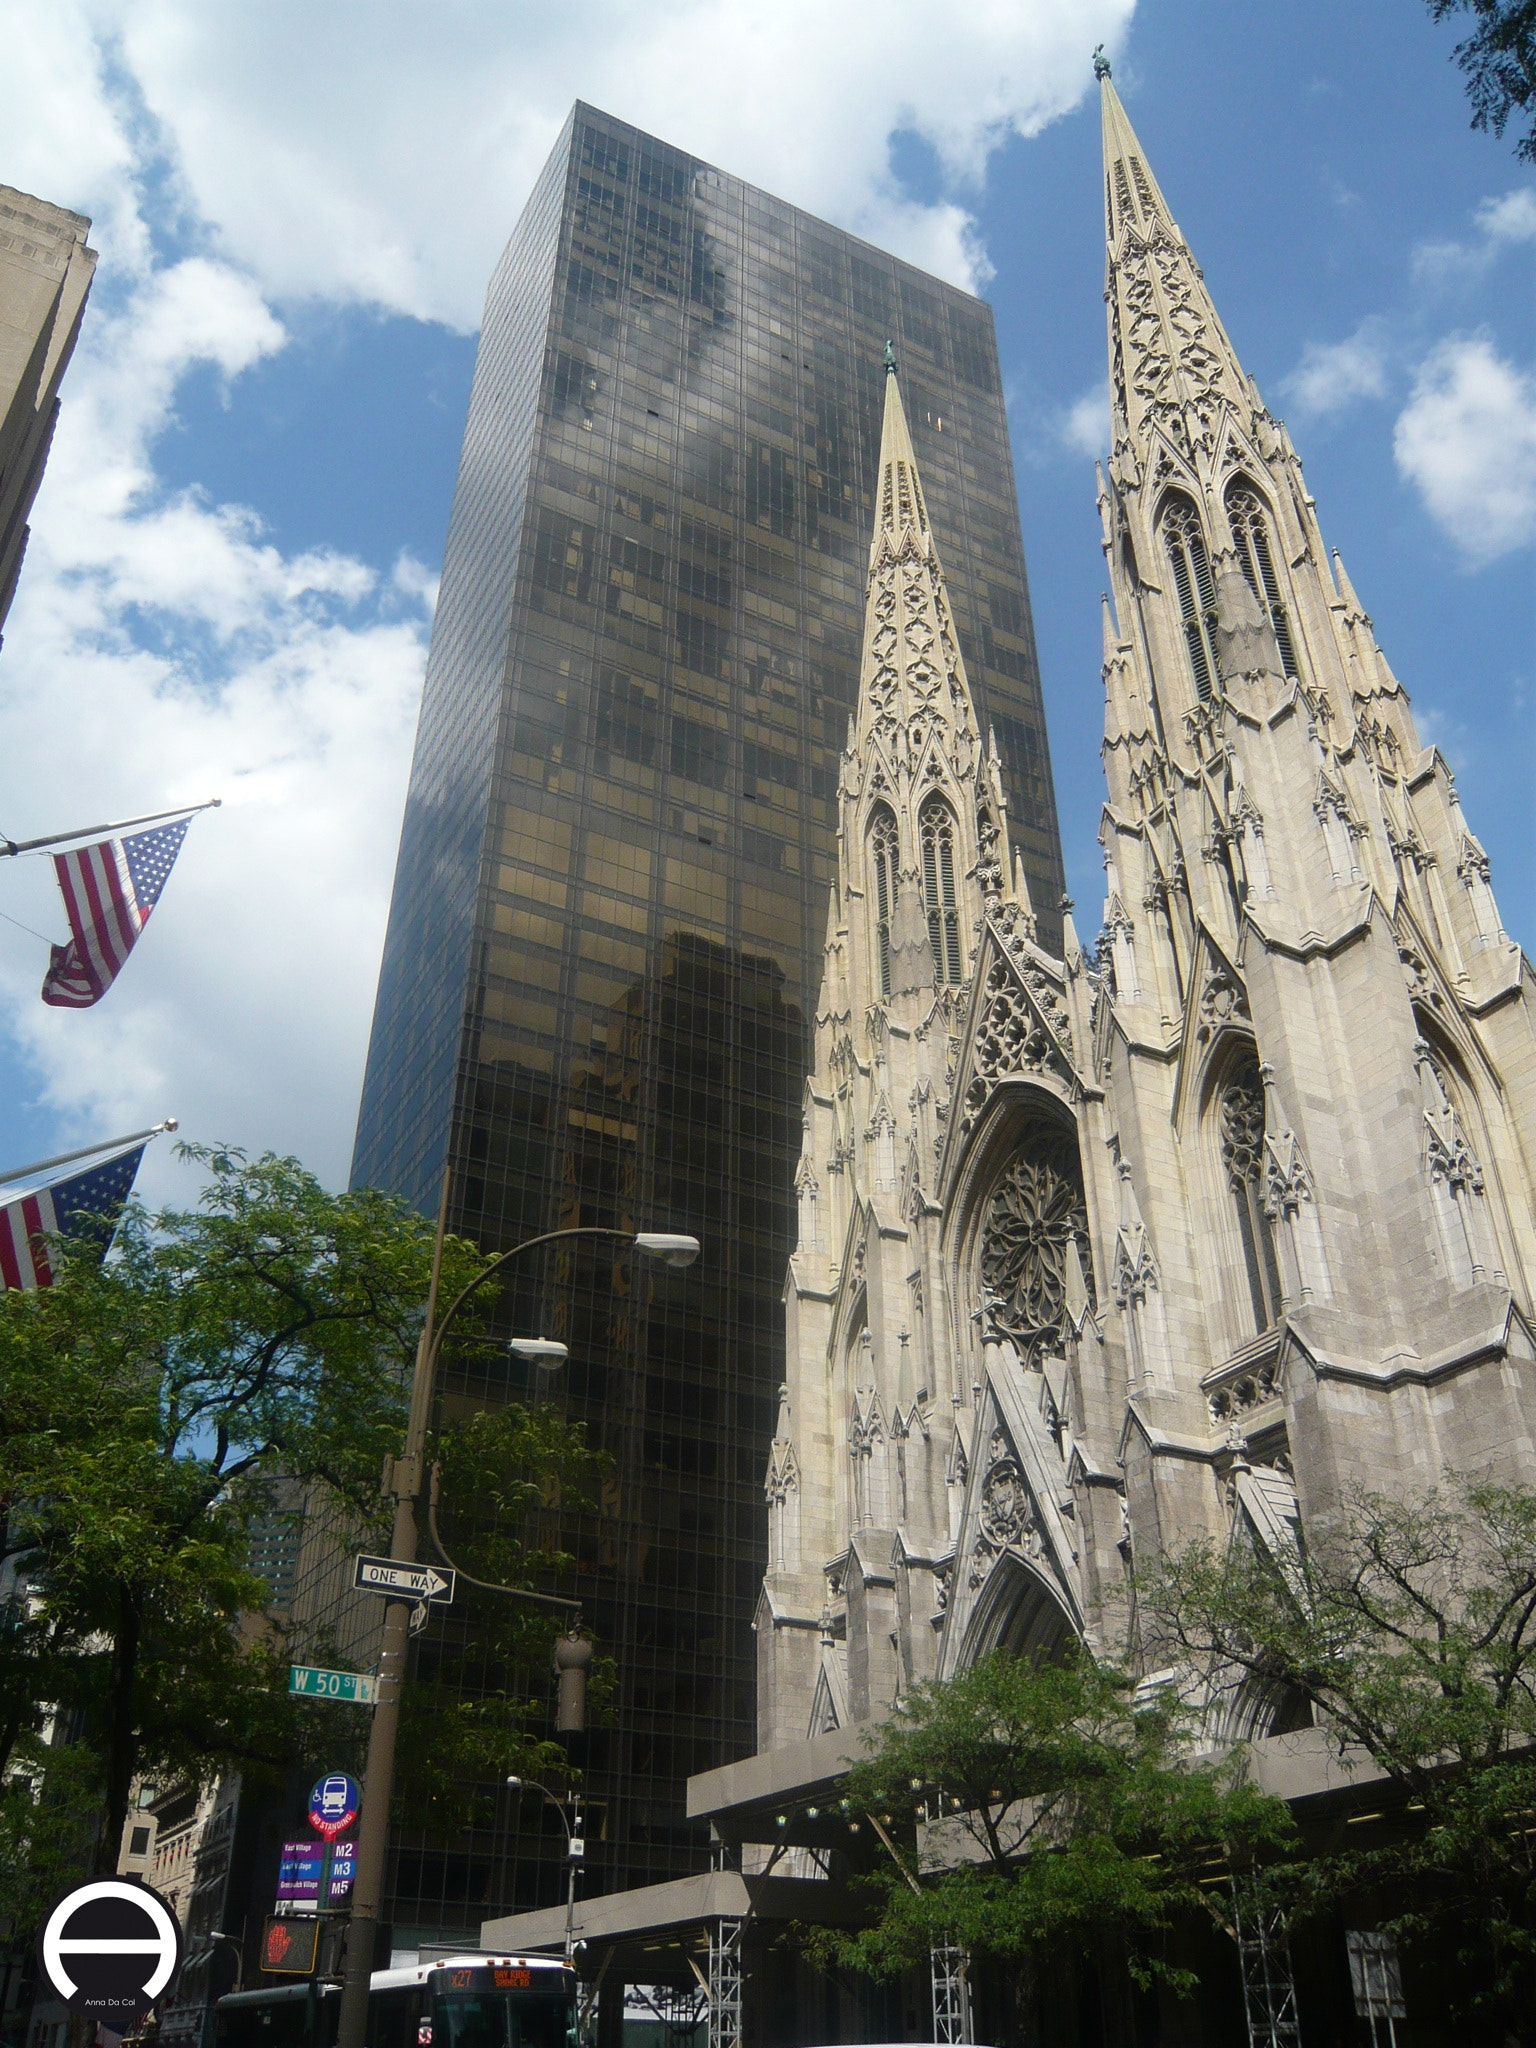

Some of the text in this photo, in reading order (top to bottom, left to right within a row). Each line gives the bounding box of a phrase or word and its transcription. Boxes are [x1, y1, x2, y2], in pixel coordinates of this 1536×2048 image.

[369, 1568, 397, 1584] ONE
[410, 1574, 439, 1589] WAY
[295, 1669, 358, 1695] W 50 ST
[312, 1813, 353, 1831] NO STANDING
[284, 1844, 312, 1852] East Village
[335, 1843, 353, 1857] M2
[334, 1861, 351, 1876] M3
[303, 1881, 318, 1889] Village
[331, 1880, 349, 1895] M5
[494, 1969, 531, 1979] BAY RIDGE
[495, 1979, 530, 1987] SHORE RD
